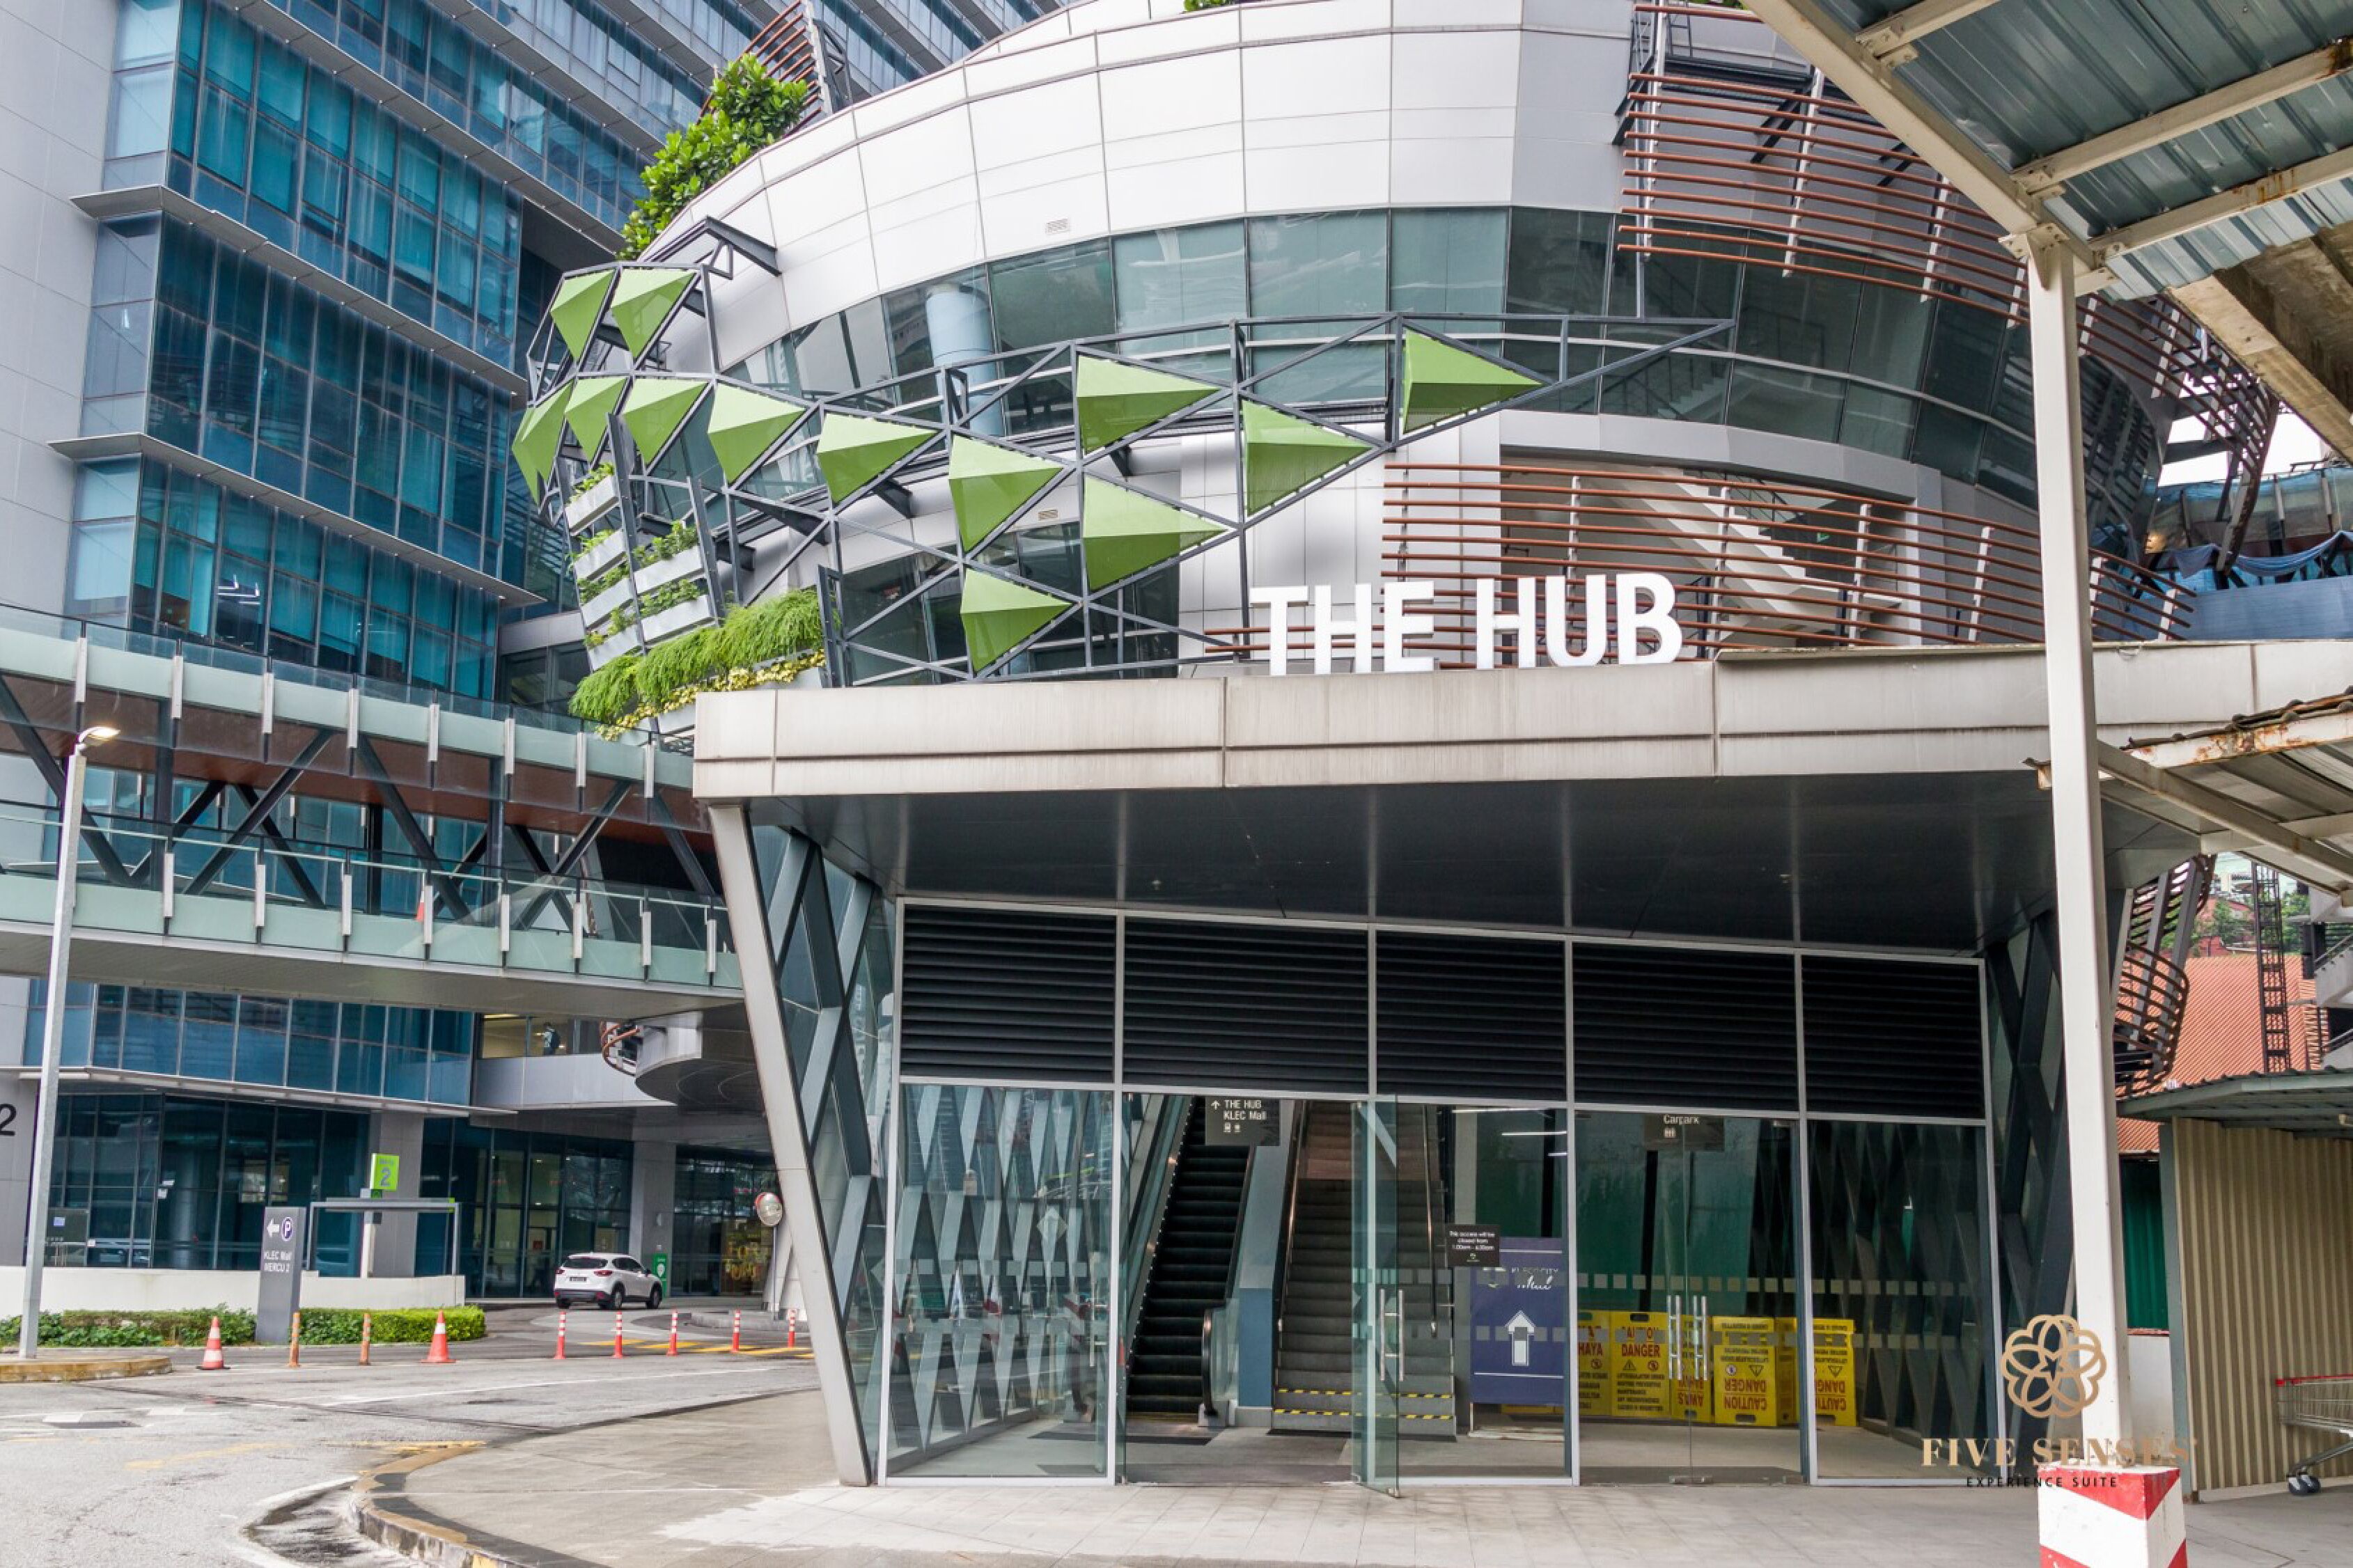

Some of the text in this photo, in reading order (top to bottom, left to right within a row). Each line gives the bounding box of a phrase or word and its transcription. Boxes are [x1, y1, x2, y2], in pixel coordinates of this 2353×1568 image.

[1250, 573, 1682, 676] THE HUB
[1224, 1099, 1262, 1109] THE HUB
[0, 1104, 17, 1136] 2
[1224, 1111, 1267, 1120] KLEC Mall
[380, 1167, 391, 1186] 2
[1622, 1343, 1660, 1358] DANGER
[1724, 1379, 1767, 1393] DANGER
[1815, 1379, 1845, 1393] DANG
[1724, 1395, 1767, 1411] CAUTION
